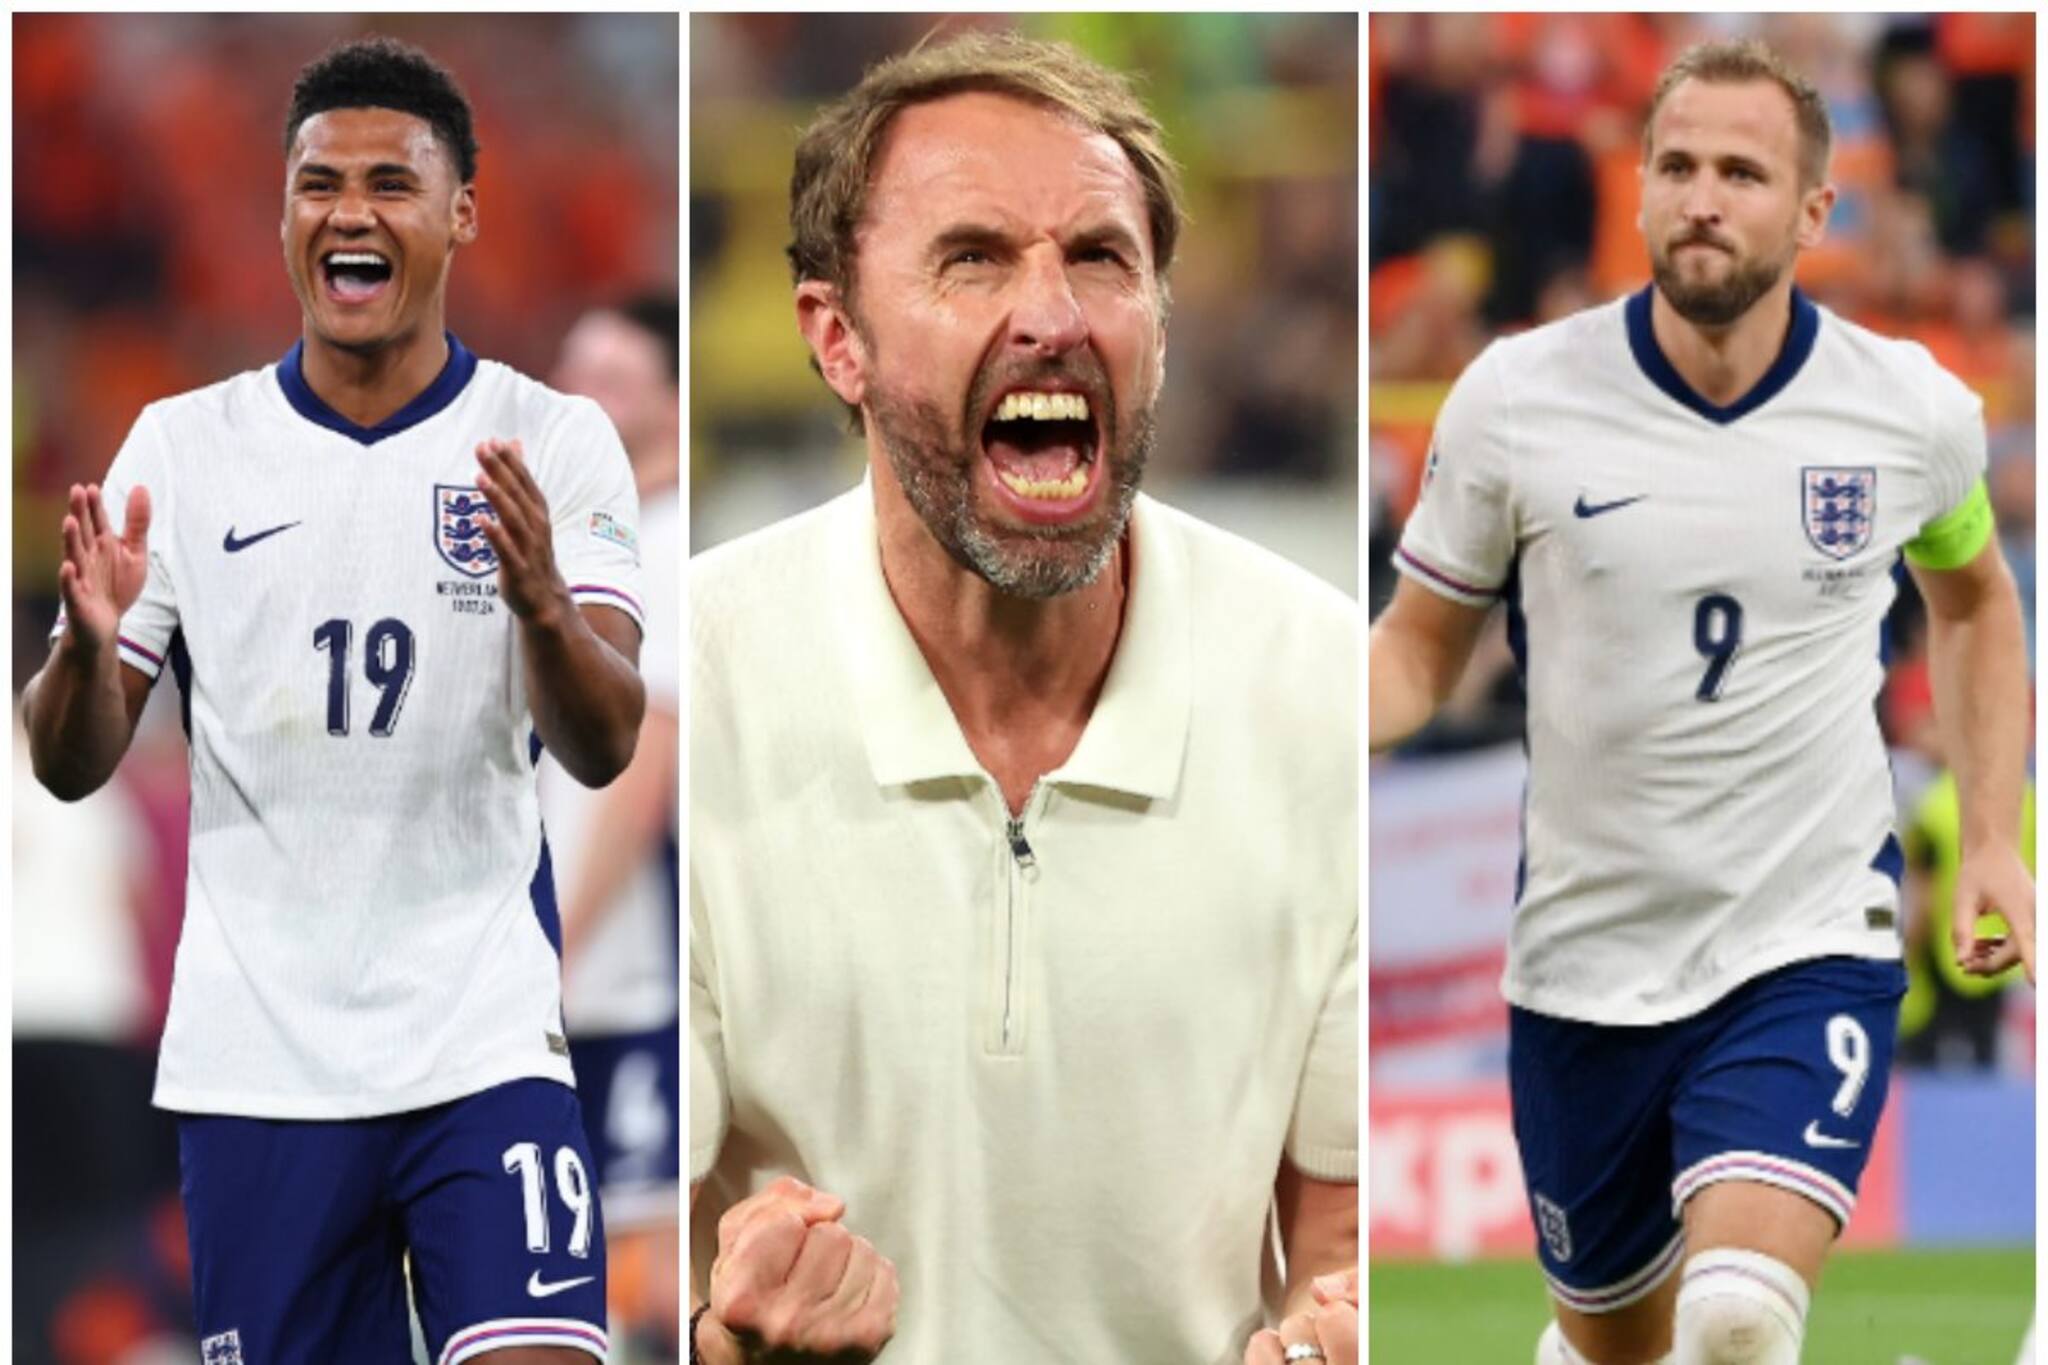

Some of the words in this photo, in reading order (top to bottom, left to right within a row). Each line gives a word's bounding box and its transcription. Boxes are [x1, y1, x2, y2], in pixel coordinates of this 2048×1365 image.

[313, 617, 416, 737] 19
[1695, 594, 1743, 703] 9
[1826, 1013, 1869, 1117] 9
[502, 1142, 594, 1259] 19
